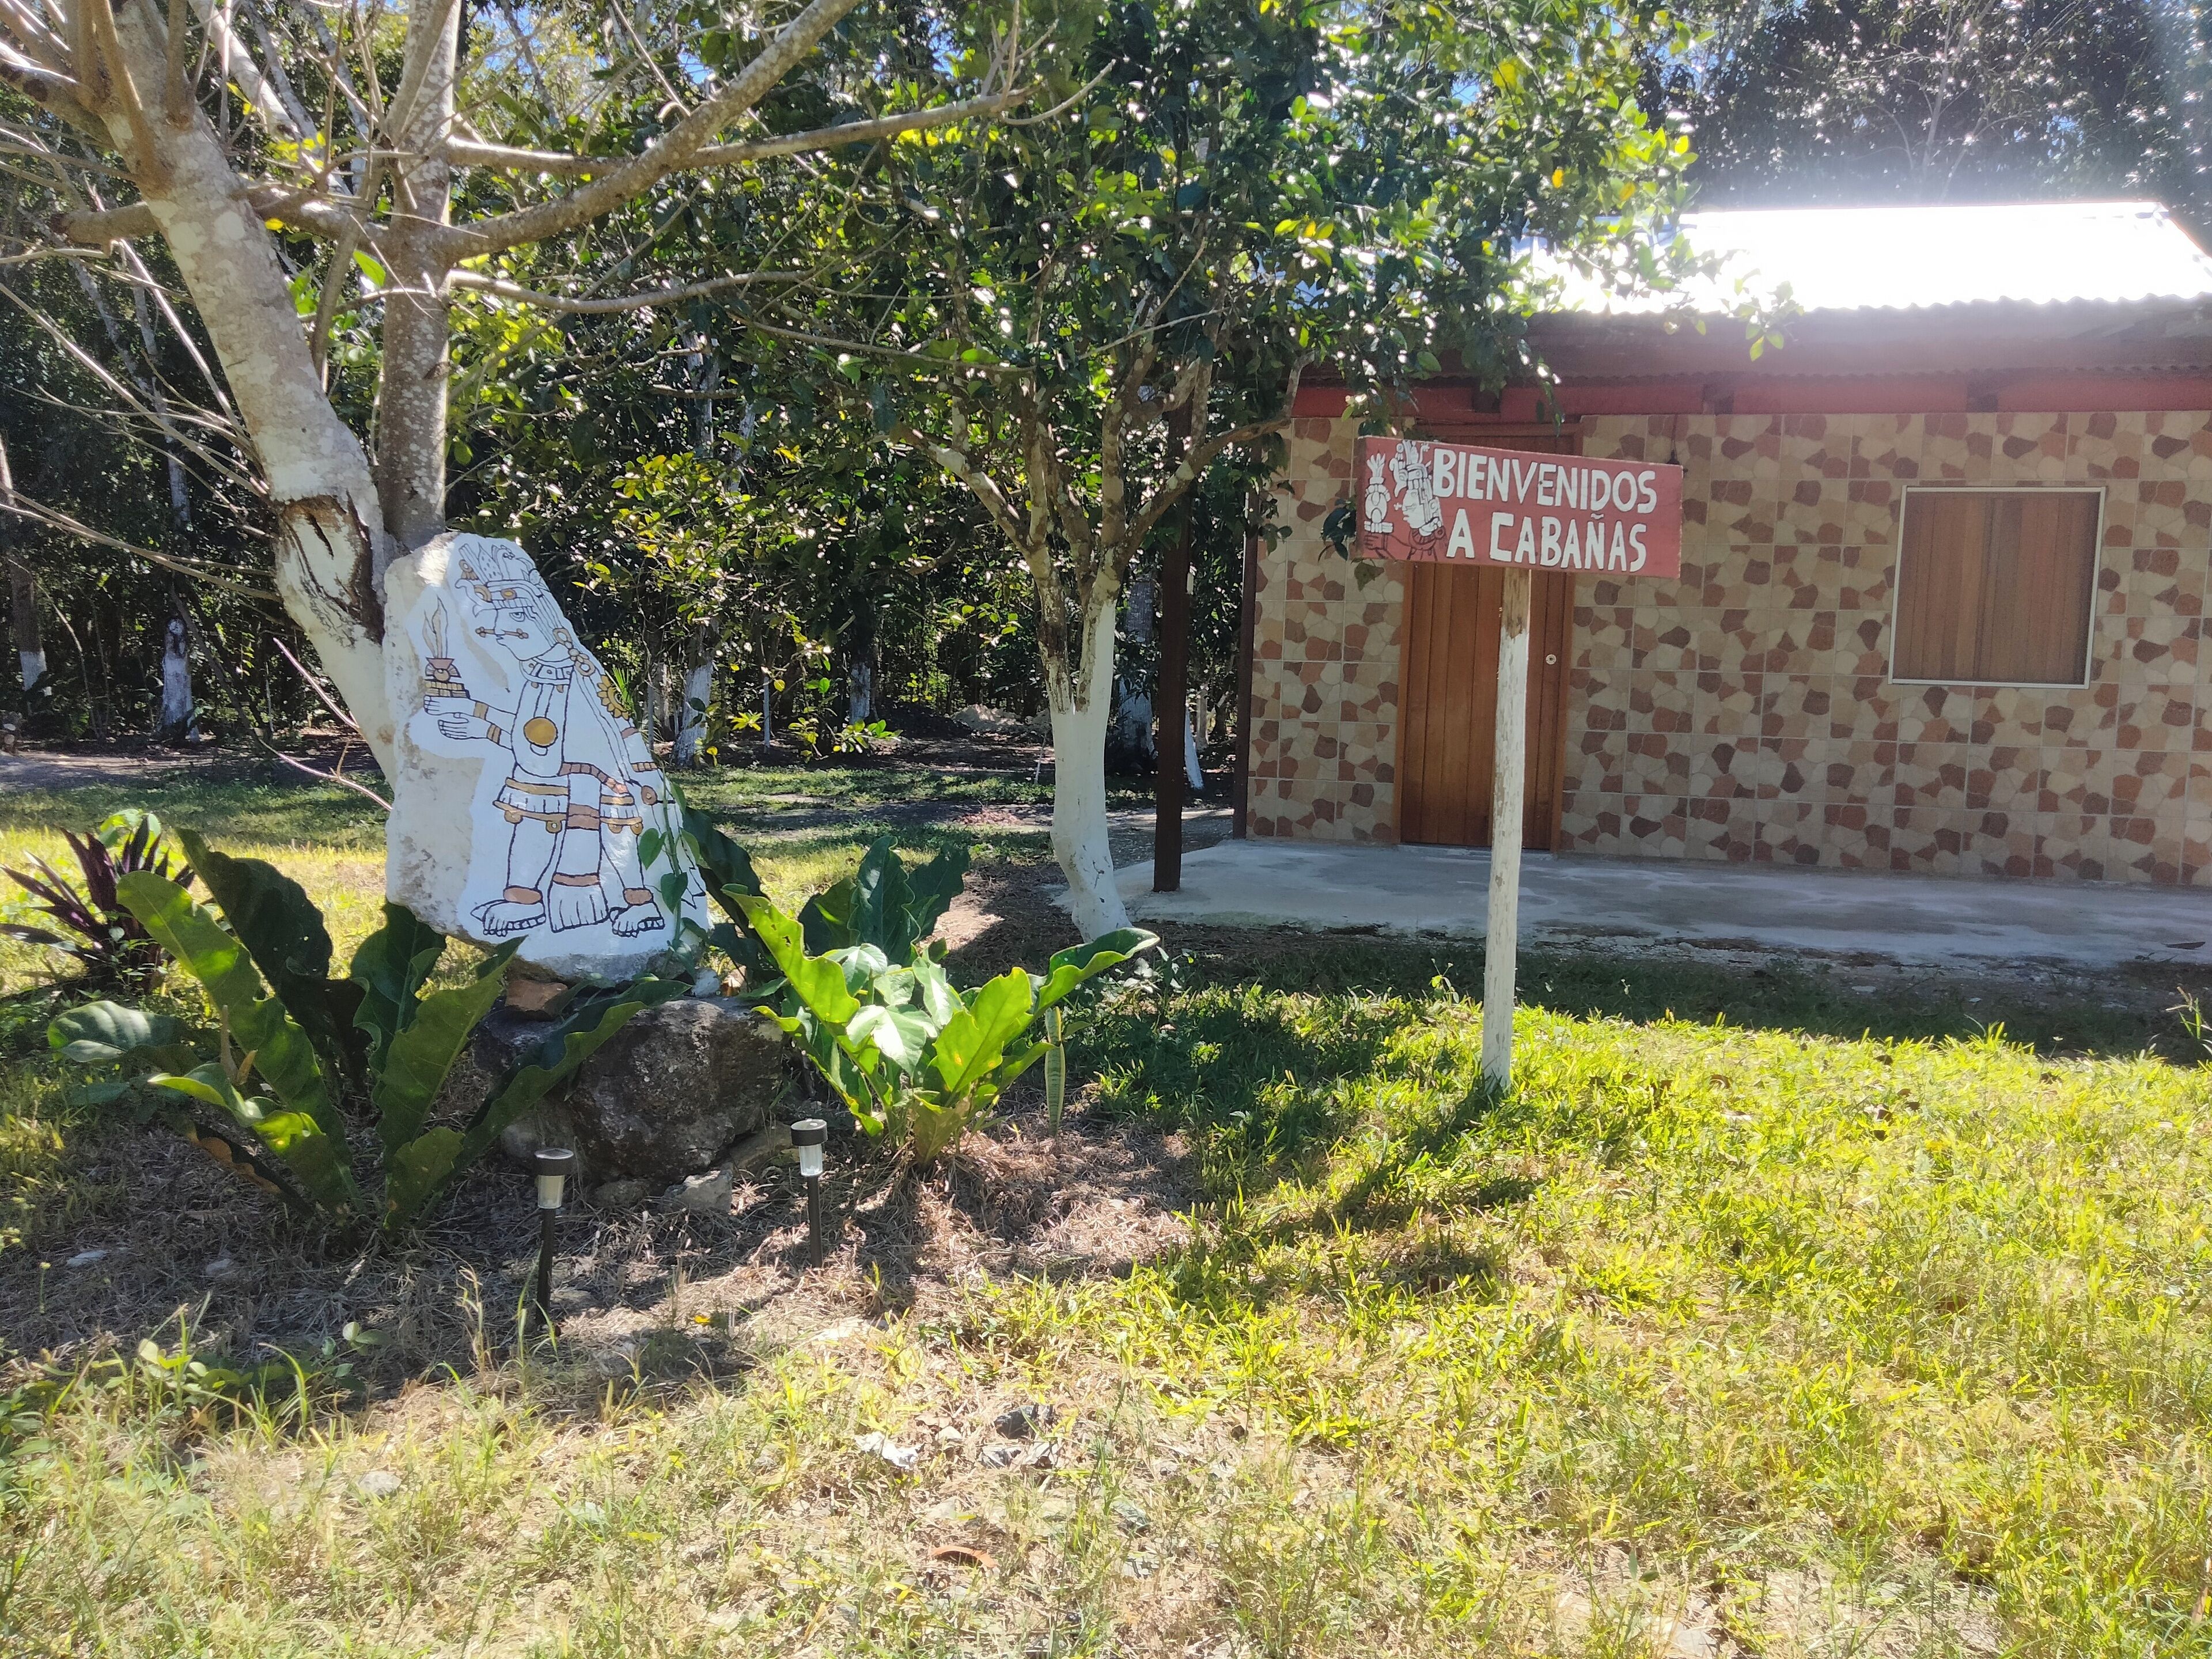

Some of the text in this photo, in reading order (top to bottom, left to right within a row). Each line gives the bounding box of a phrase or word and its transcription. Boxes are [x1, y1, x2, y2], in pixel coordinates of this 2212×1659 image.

[1433, 448, 1657, 514] BIENVENIDOS
[1446, 508, 1646, 572] A CABAÑAS
